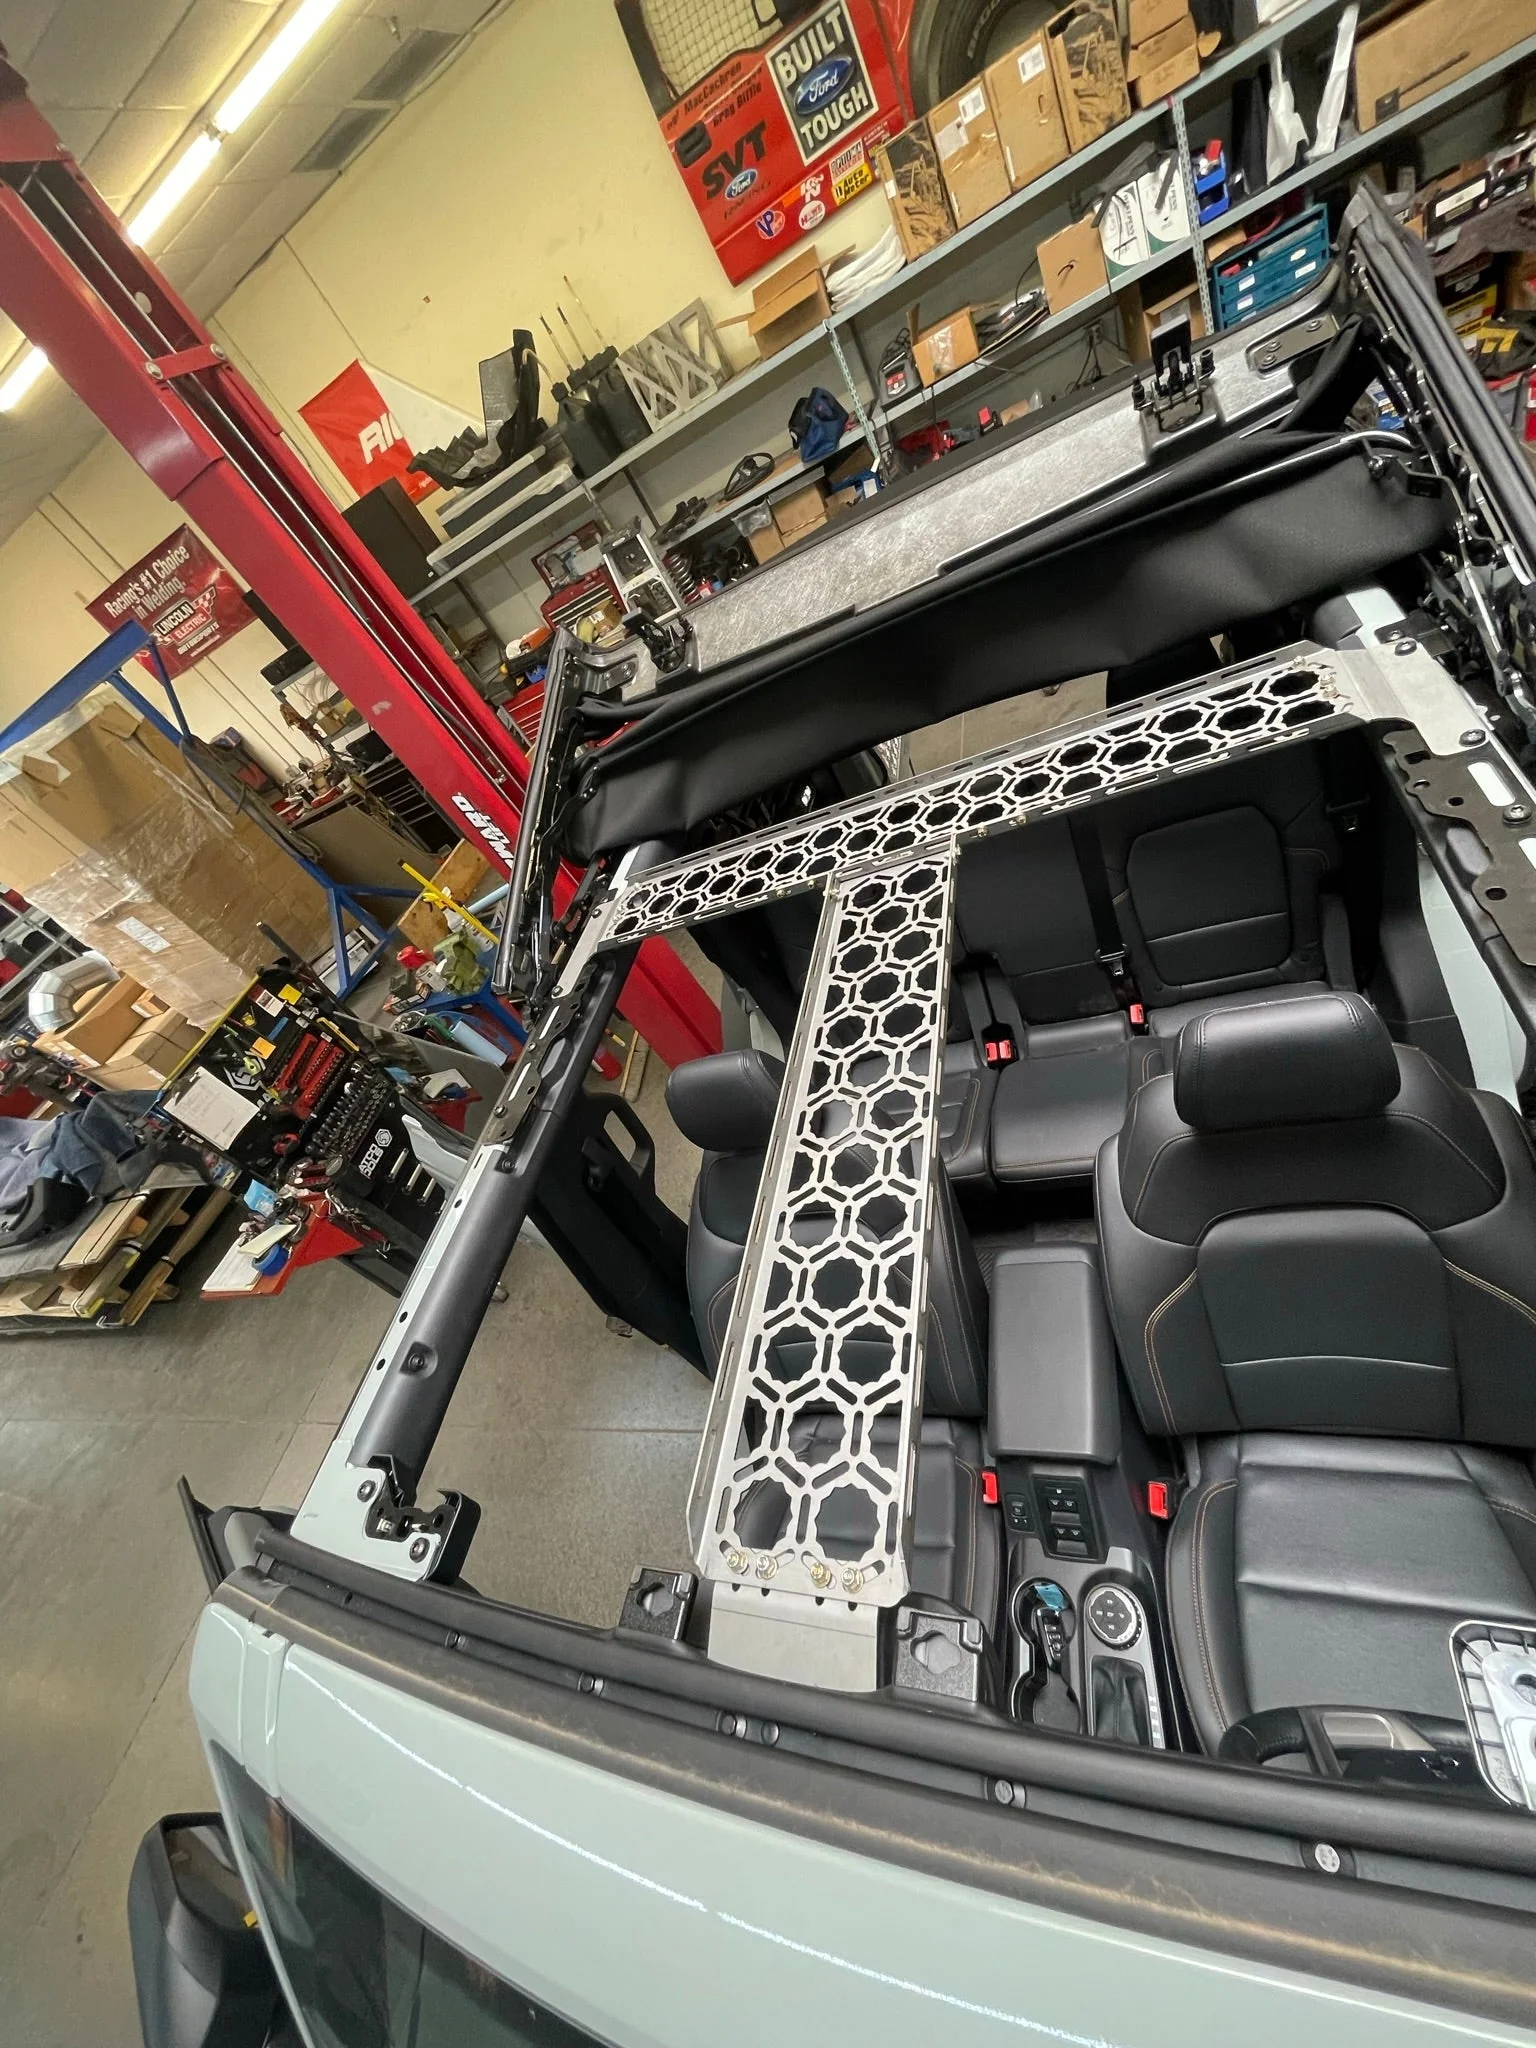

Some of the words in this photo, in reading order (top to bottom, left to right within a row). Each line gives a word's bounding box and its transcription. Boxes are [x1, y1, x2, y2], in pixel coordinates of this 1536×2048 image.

[776, 6, 845, 89] BUILT
[808, 67, 840, 103] Ford
[800, 81, 869, 149] TOUGH
[702, 120, 766, 200] SVT
[104, 578, 145, 618] Racing's
[139, 568, 155, 591] #1
[153, 545, 190, 580] Choice
[132, 601, 148, 620] in
[143, 575, 187, 613] Welding.
[156, 602, 194, 635] LINCOLN
[174, 613, 207, 640] ELECTRIC
[479, 812, 510, 844] LIFT
[359, 1143, 378, 1172] ATCO
[364, 1147, 384, 1177] OOLS
